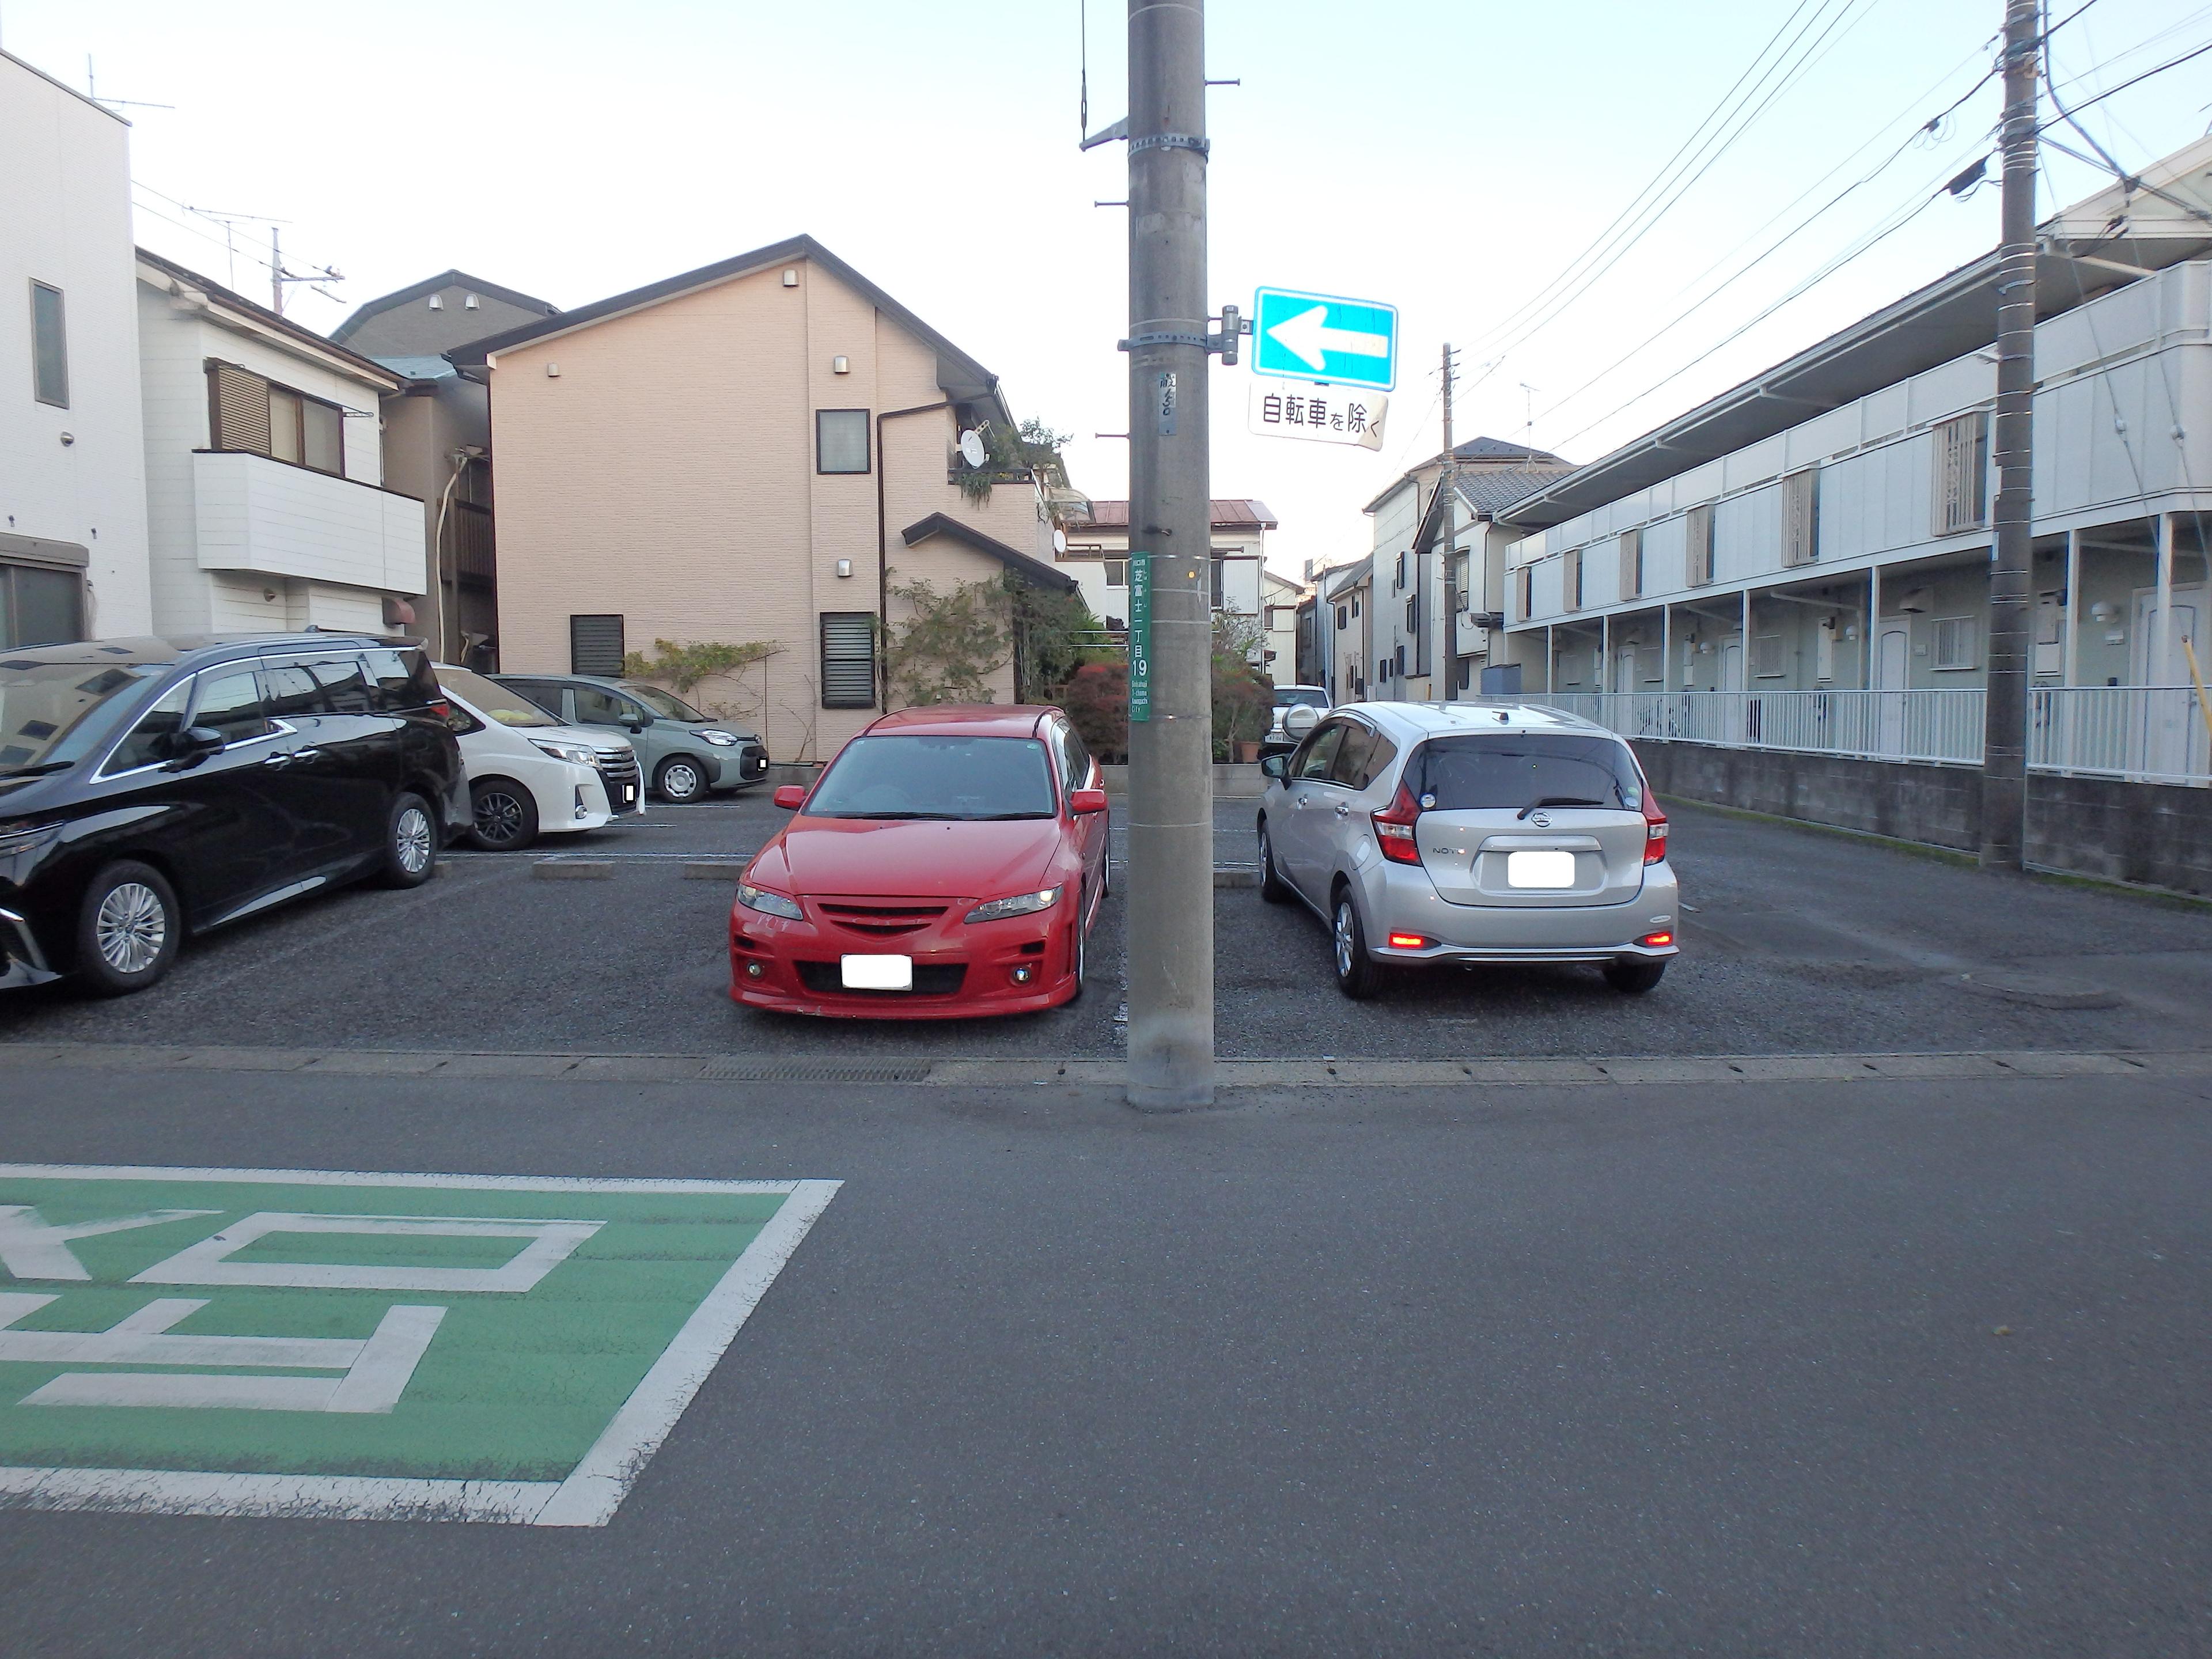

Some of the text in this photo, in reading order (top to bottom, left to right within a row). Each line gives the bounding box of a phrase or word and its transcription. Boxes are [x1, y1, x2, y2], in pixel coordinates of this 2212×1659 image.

[1263, 393, 1380, 438] 自転車を除く
[1132, 660, 1147, 676] 19
